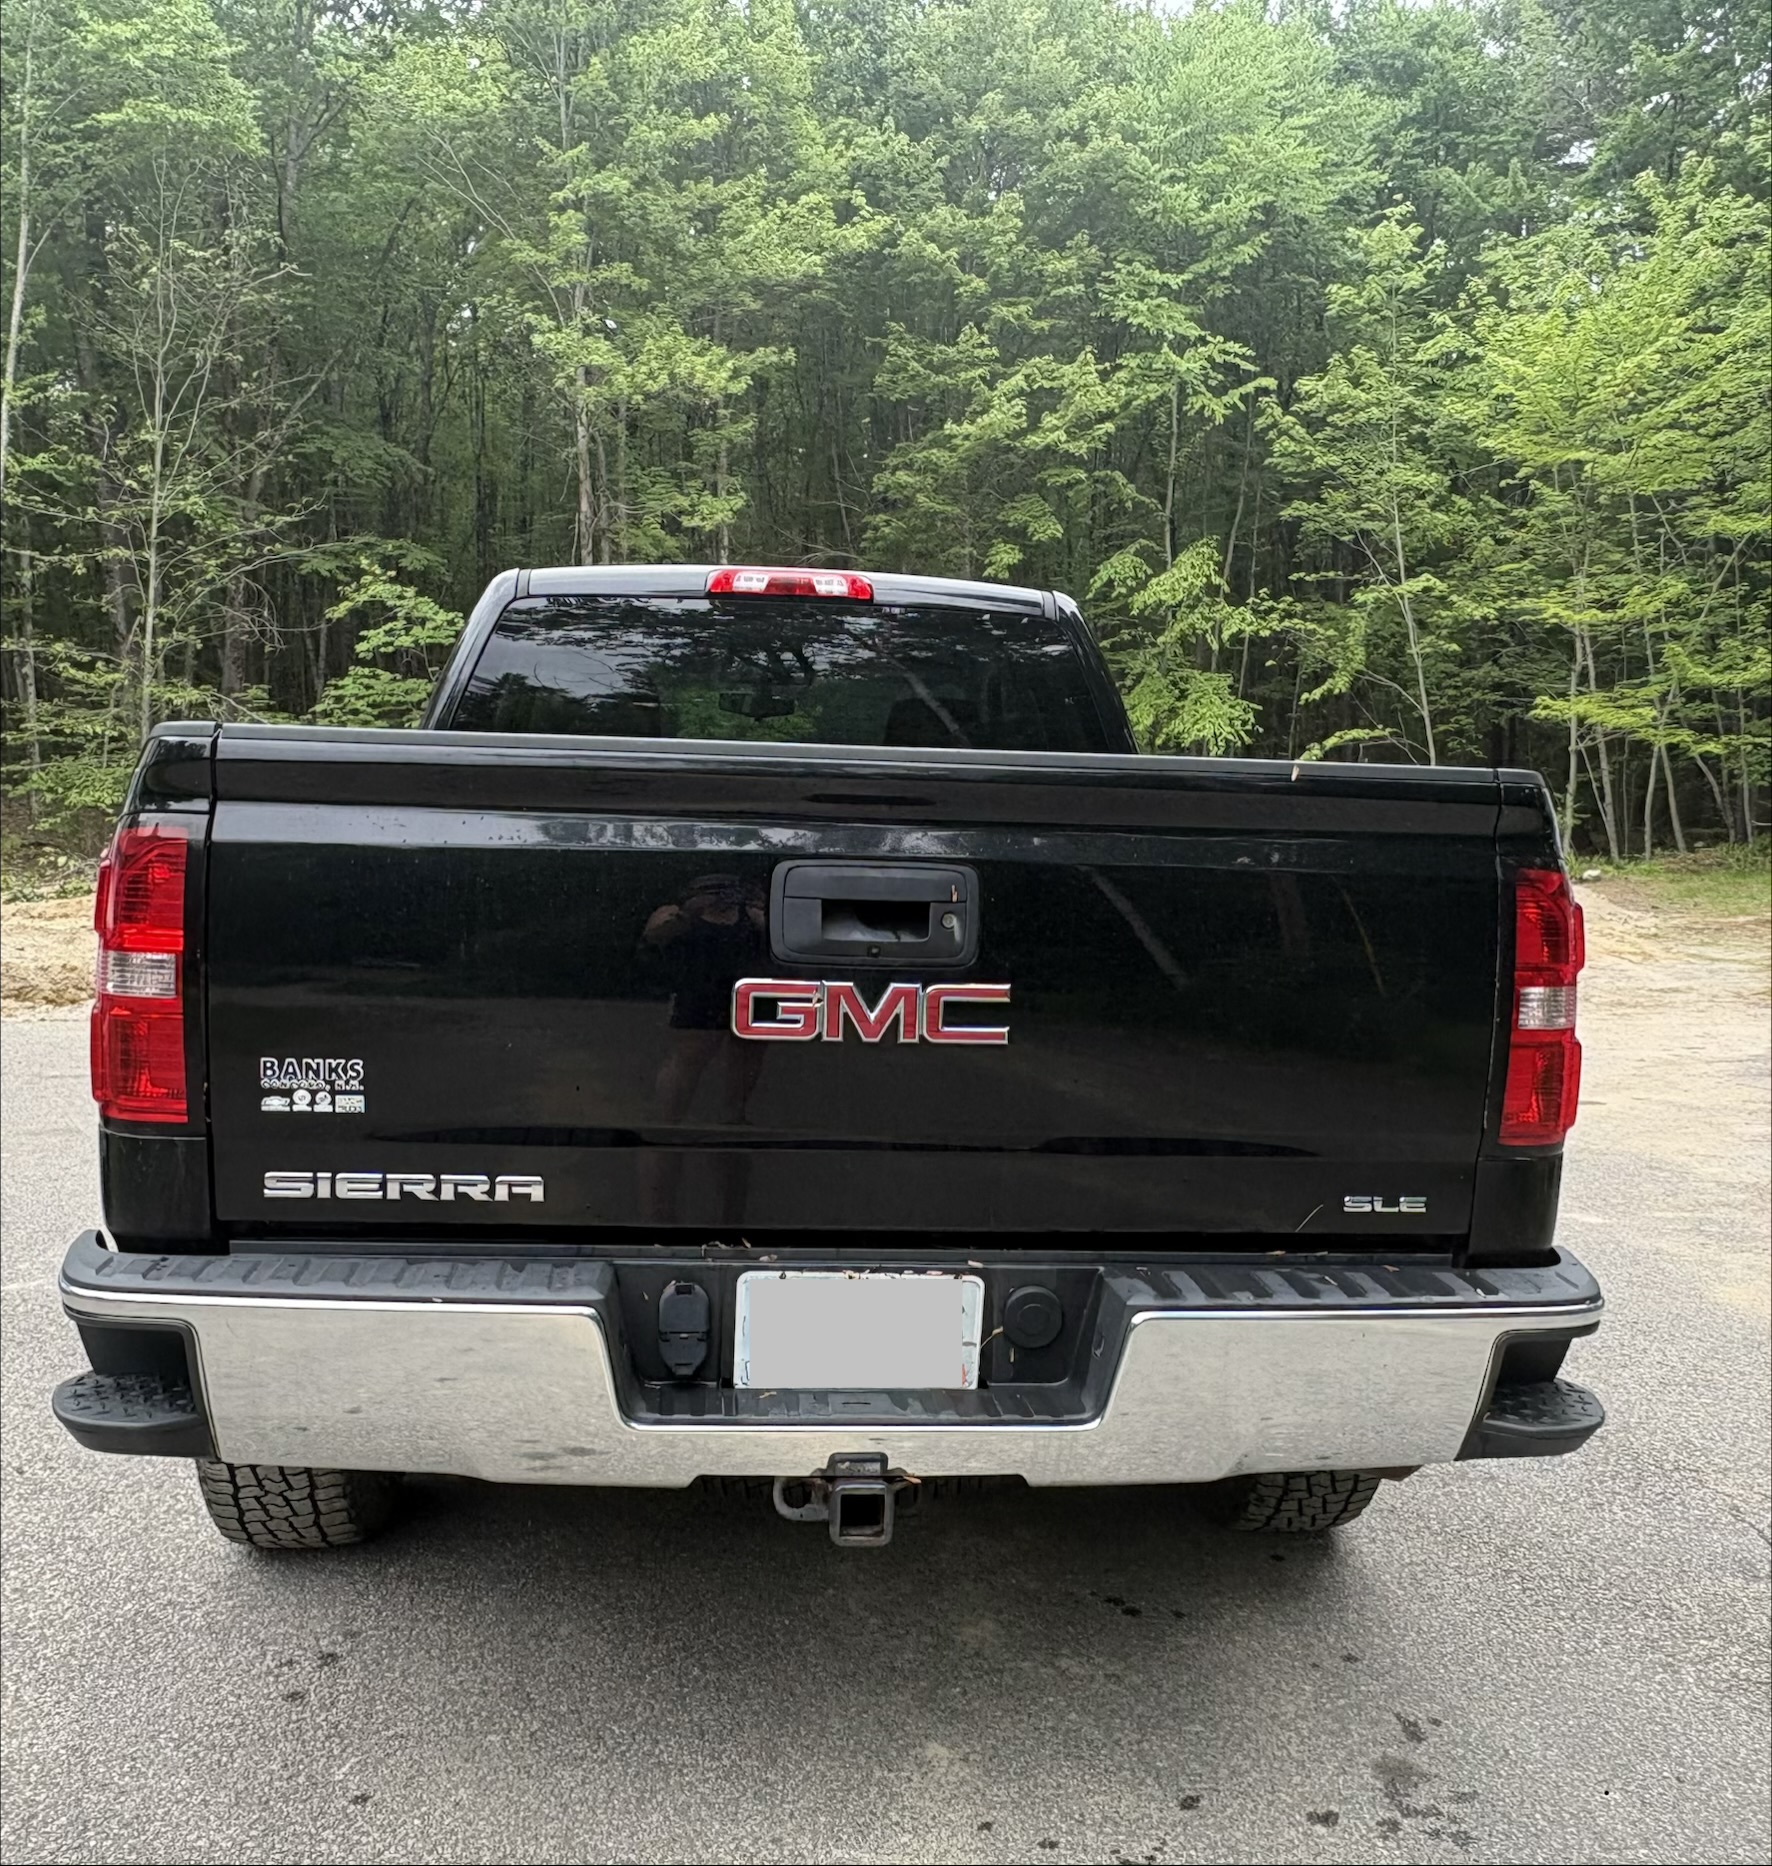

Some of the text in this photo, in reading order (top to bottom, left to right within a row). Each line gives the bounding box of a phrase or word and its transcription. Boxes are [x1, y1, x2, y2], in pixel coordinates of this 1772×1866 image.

[731, 978, 1011, 1045] GMC
[260, 1057, 364, 1081] BANKS
[263, 1171, 544, 1202] SIERRA
[1343, 1196, 1427, 1213] SLE
